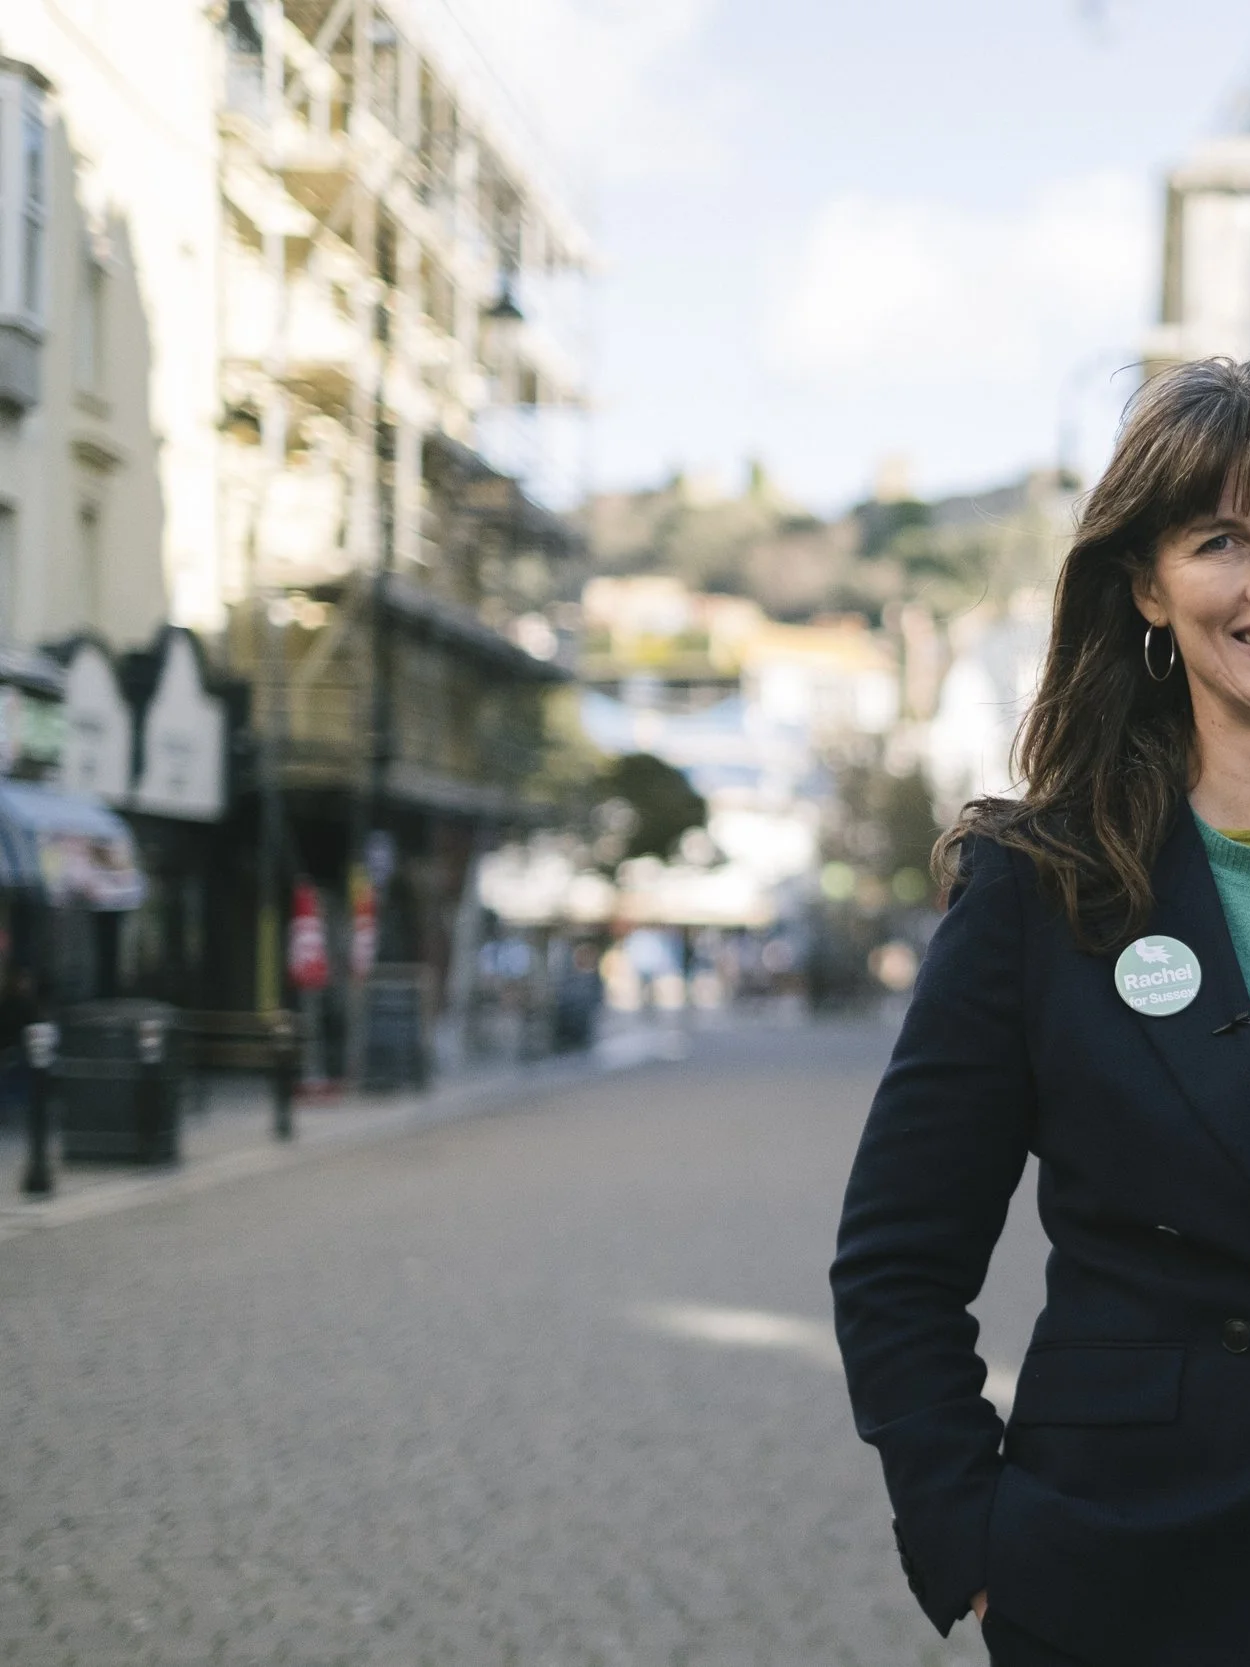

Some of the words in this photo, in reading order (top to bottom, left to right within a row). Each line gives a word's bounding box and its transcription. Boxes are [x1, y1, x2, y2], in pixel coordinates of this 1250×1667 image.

[1124, 964, 1193, 991] Rachel
[1129, 996, 1148, 1008] for
[1149, 988, 1196, 1004] Sussex
